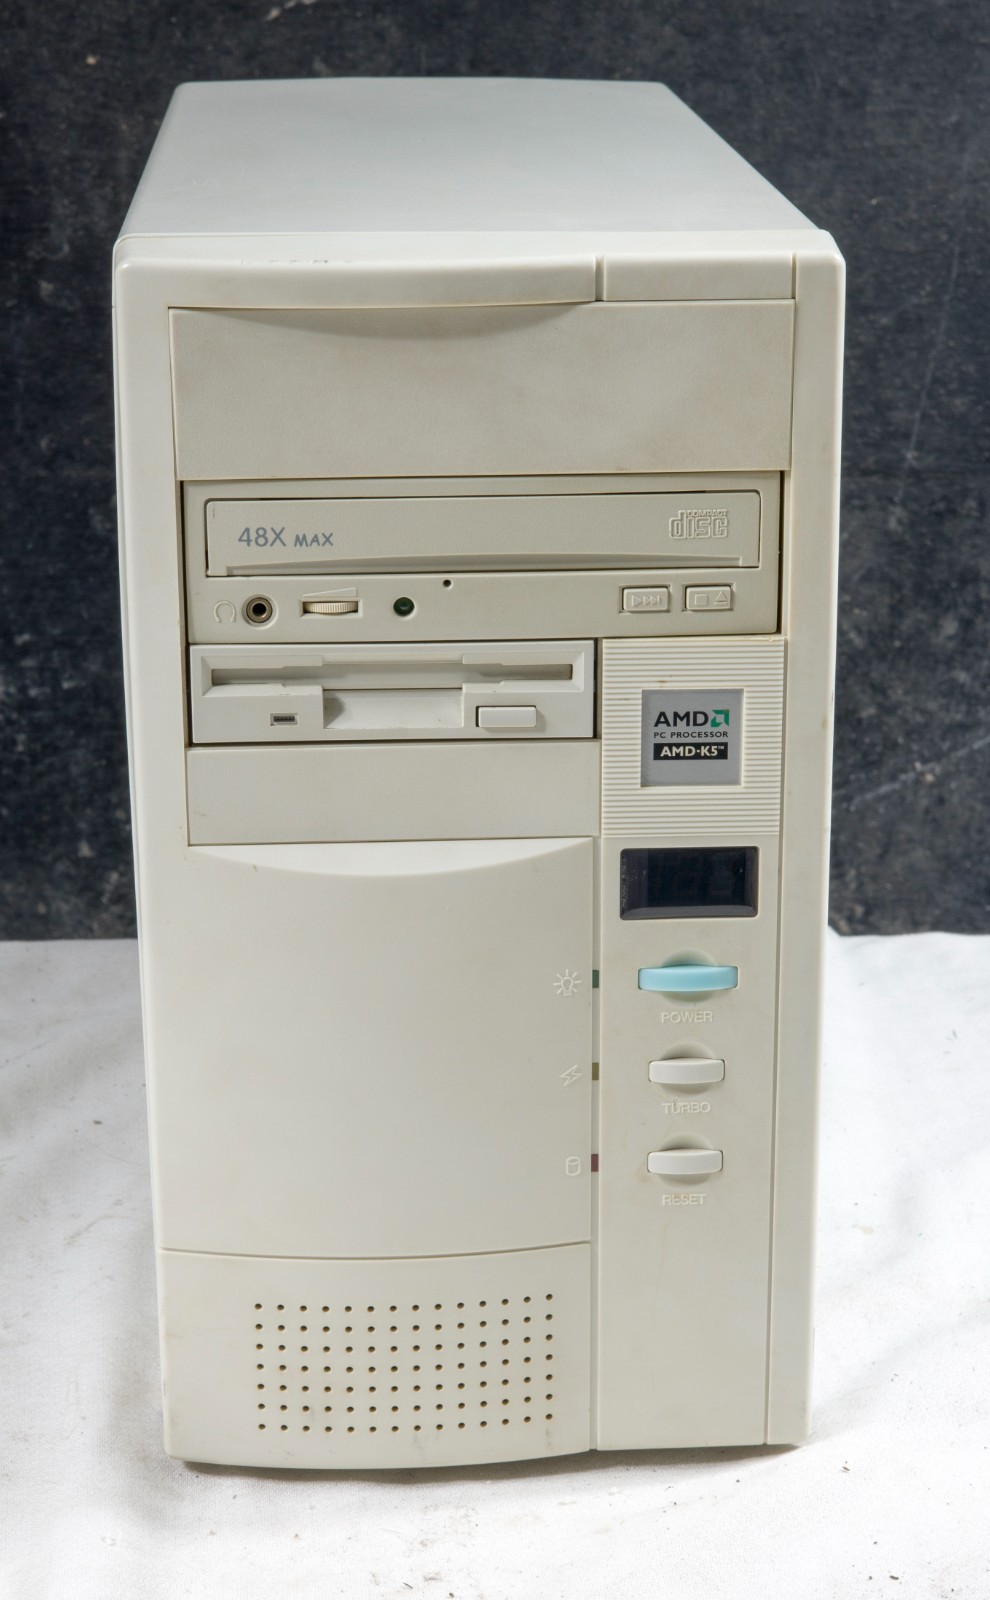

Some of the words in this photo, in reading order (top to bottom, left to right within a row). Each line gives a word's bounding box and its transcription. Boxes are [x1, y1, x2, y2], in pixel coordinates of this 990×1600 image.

[686, 508, 728, 517] COMPACT
[238, 527, 287, 547] 48X
[294, 532, 334, 547] MAX
[653, 711, 709, 727] AMD
[653, 731, 667, 739] PC
[670, 731, 729, 739] PROCESSOR
[661, 1010, 713, 1024] POWER
[661, 1101, 711, 1114] TURBO
[662, 1193, 707, 1206] RESET
